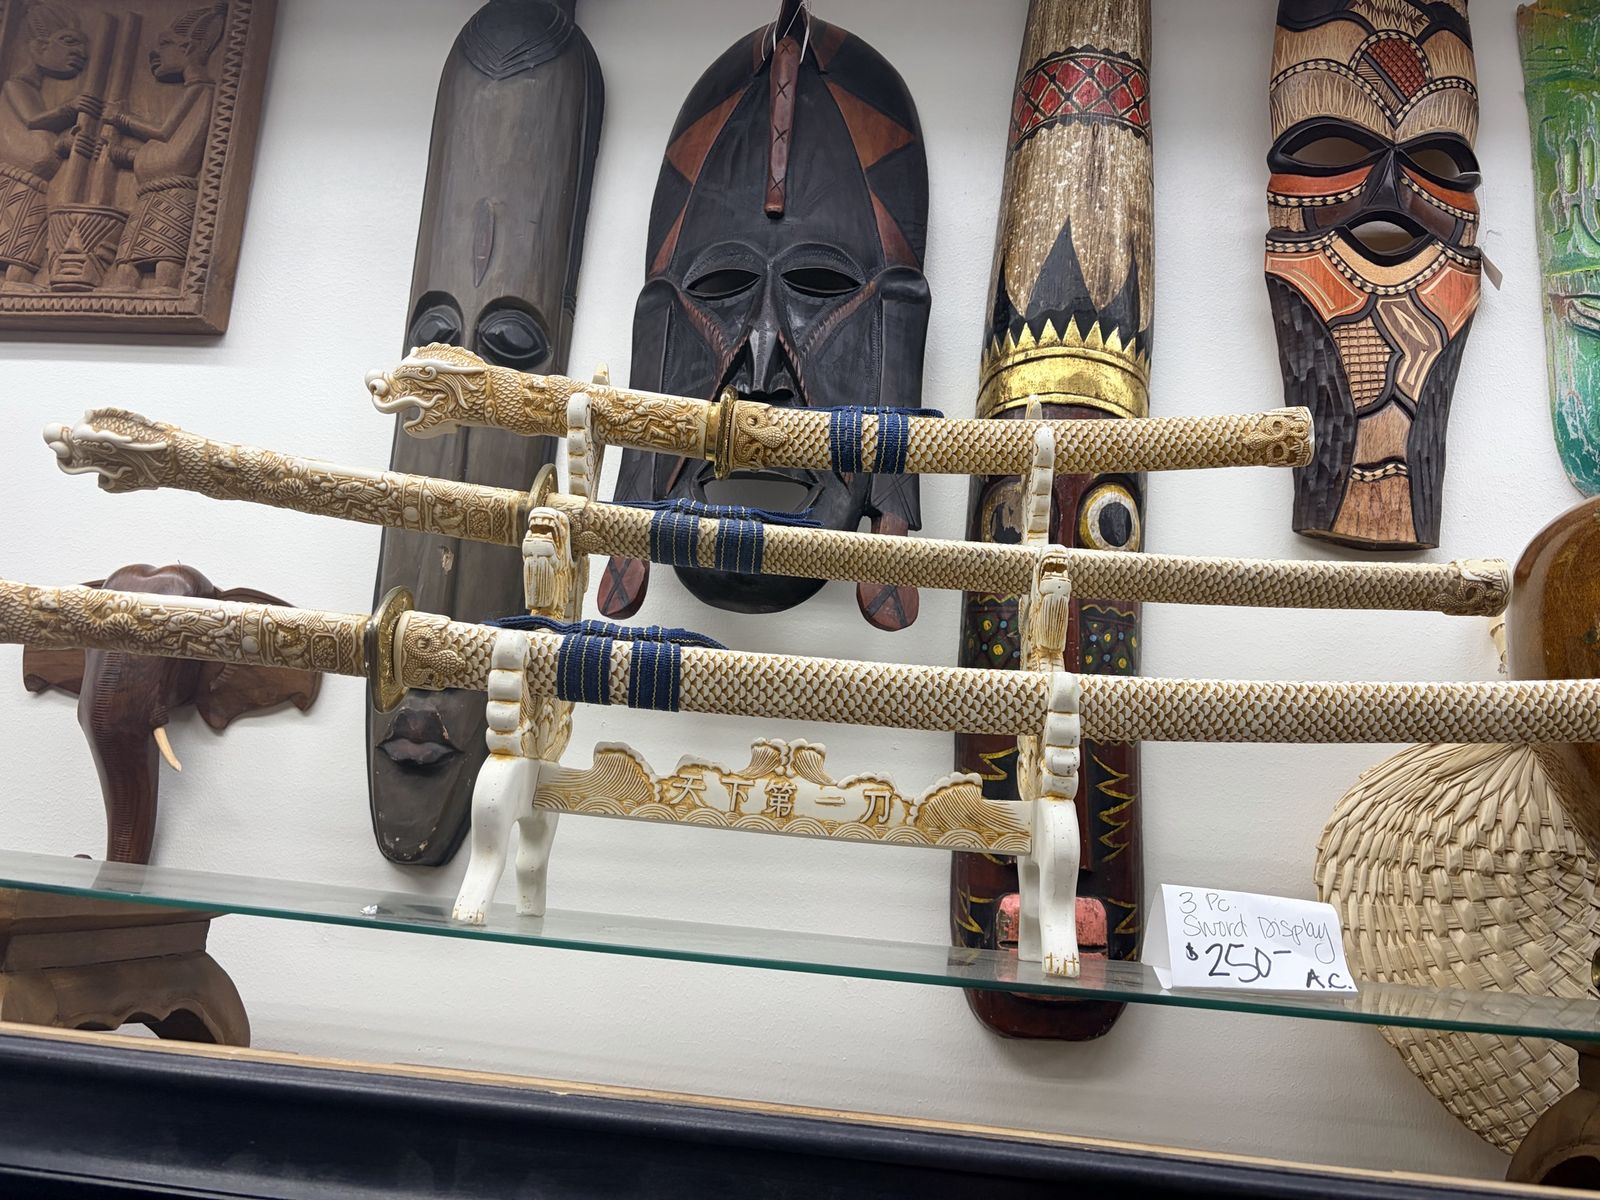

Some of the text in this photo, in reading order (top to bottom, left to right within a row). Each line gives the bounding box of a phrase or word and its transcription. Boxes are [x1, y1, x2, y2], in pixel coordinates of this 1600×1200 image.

[670, 774, 892, 824] 天下第一刀
[1179, 891, 1197, 914] 3
[1183, 914, 1336, 964] Sword Display
